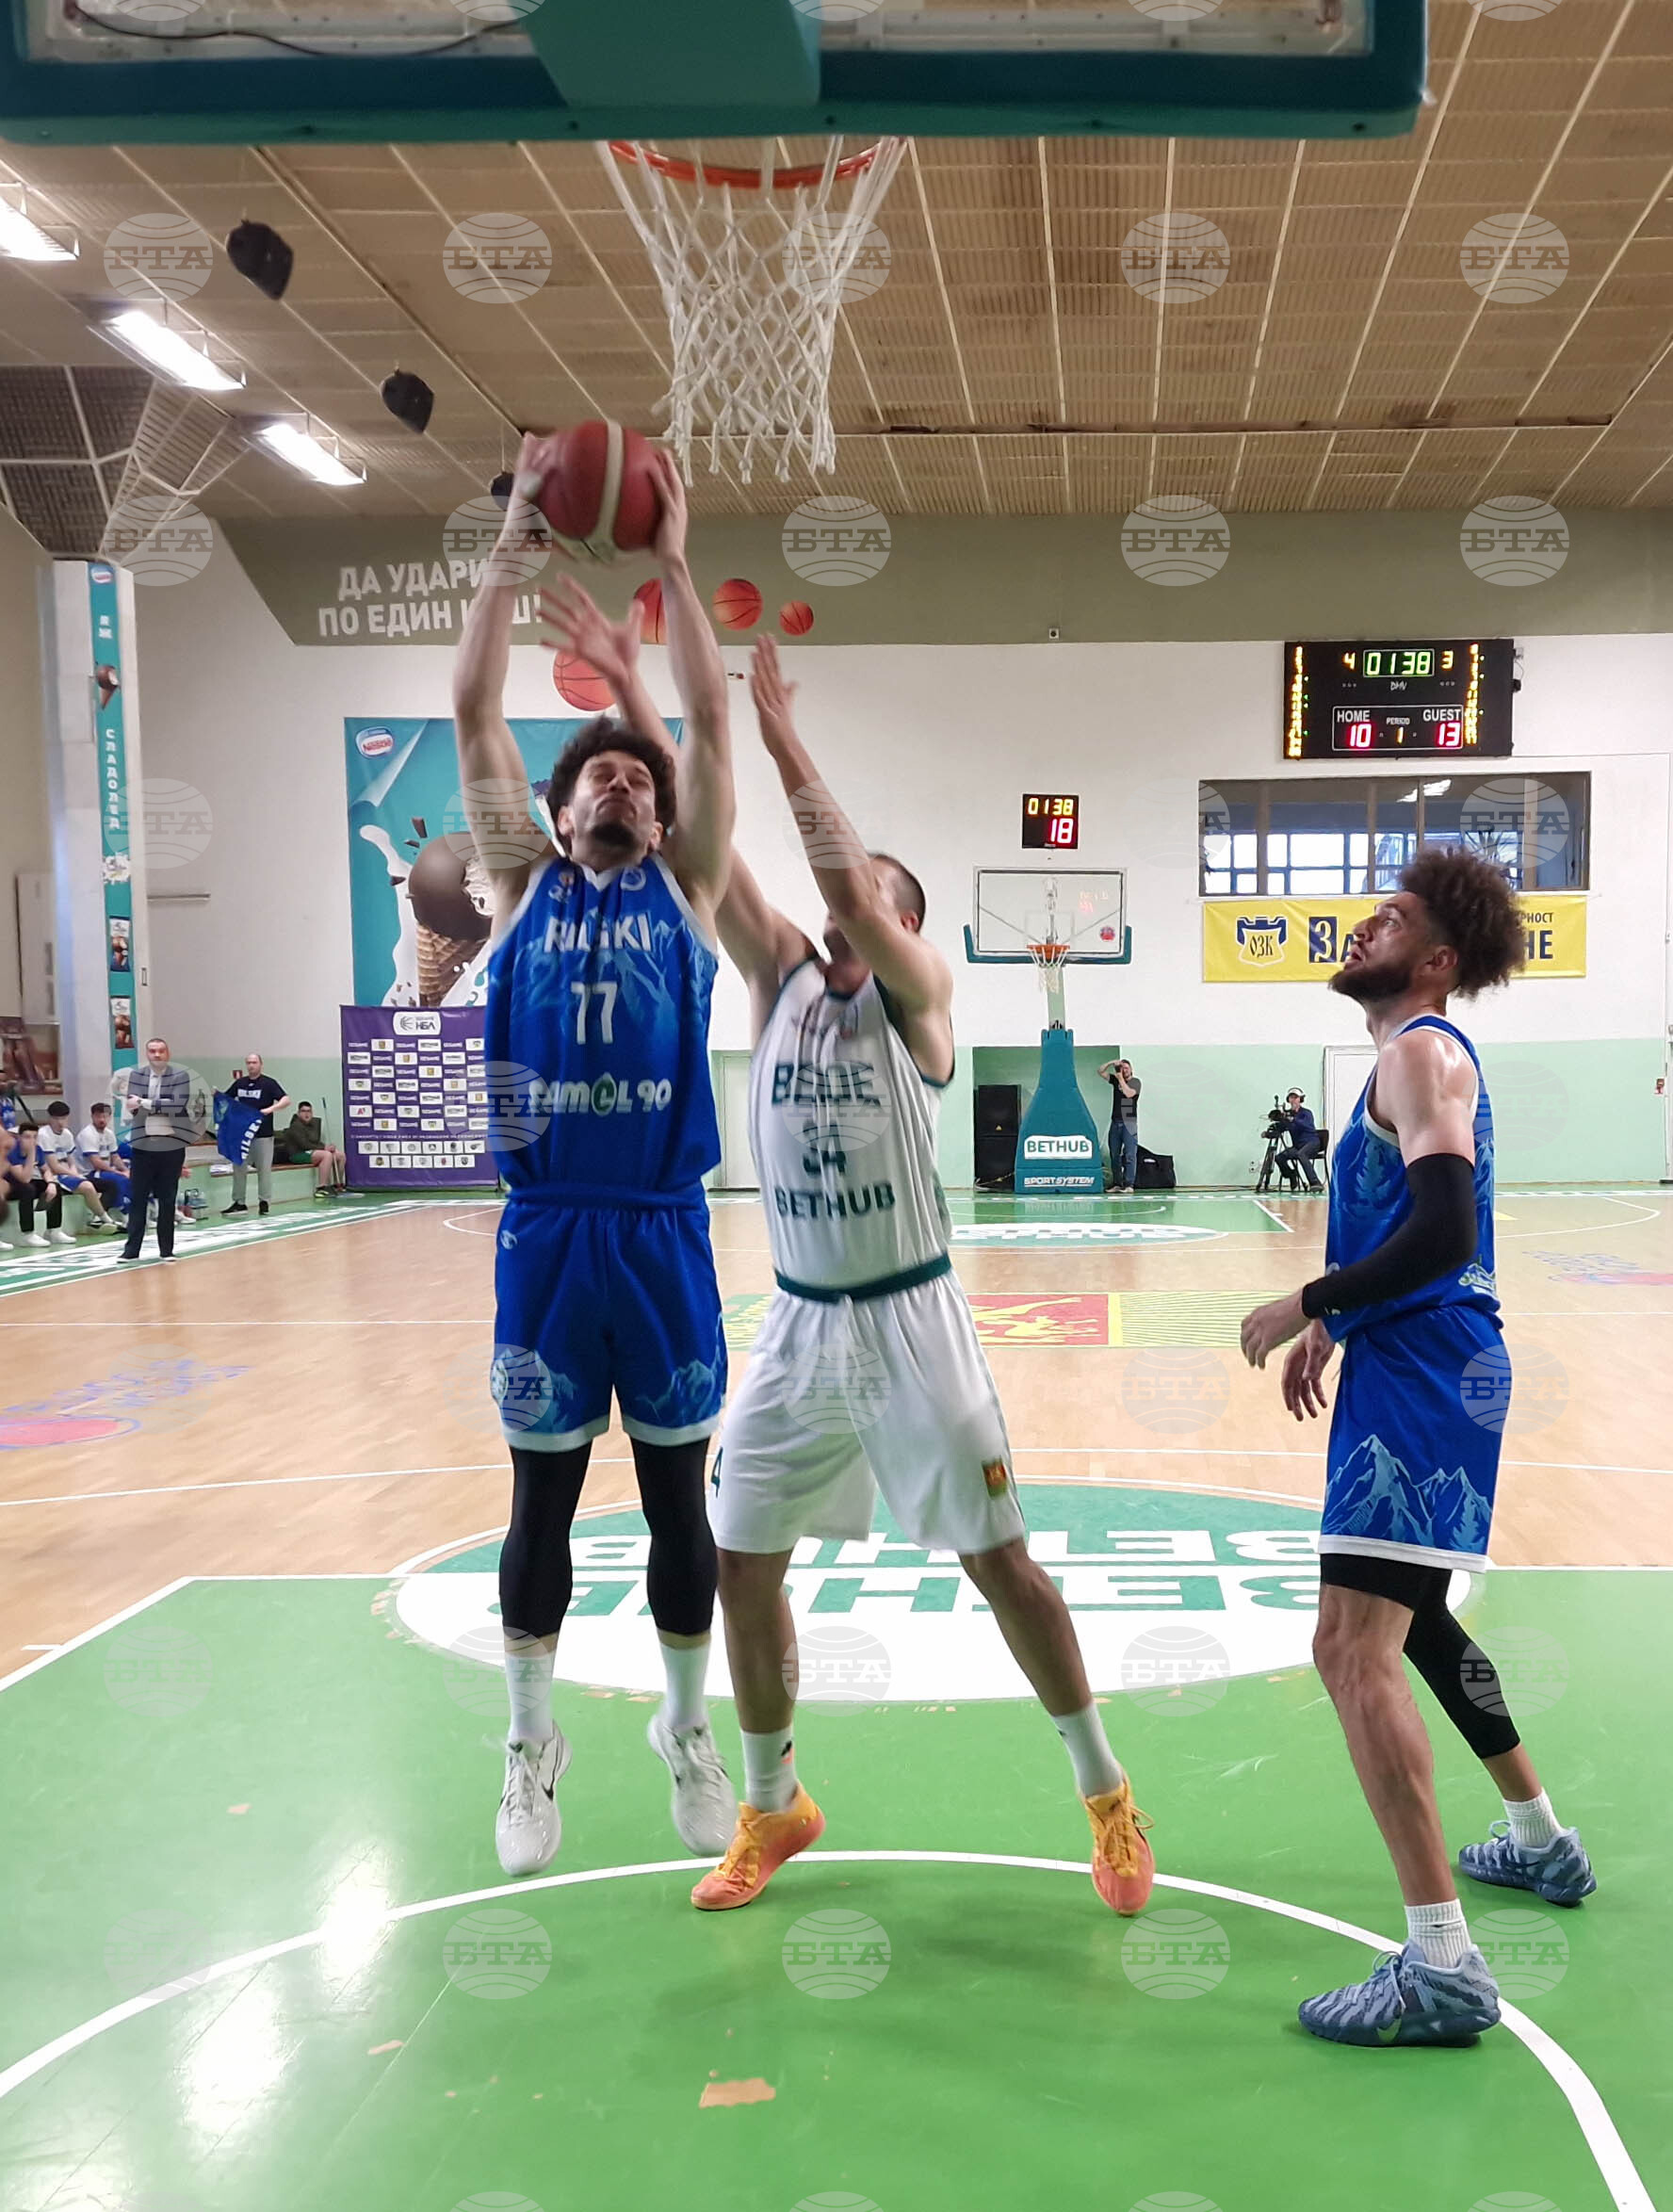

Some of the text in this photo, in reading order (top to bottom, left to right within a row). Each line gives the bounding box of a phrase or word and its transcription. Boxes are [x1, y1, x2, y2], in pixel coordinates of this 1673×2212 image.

[338, 558, 492, 601] ДА УДАРИ
[318, 607, 359, 637] ПО
[367, 599, 452, 637] ЕДИН
[1342, 652, 1356, 669] 4
[1441, 650, 1454, 669] 3
[1337, 709, 1371, 723] HOME
[1386, 716, 1410, 725] PERIOD
[1422, 708, 1461, 722] GUEST
[1349, 723, 1372, 747] 10
[1397, 726, 1405, 744] 1
[1437, 722, 1461, 747] 13
[1049, 817, 1074, 844] 18
[570, 982, 618, 1045] 77
[637, 1079, 672, 1113] 90
[1027, 1140, 1090, 1153] BETHUB
[774, 1182, 895, 1219] BETHUB
